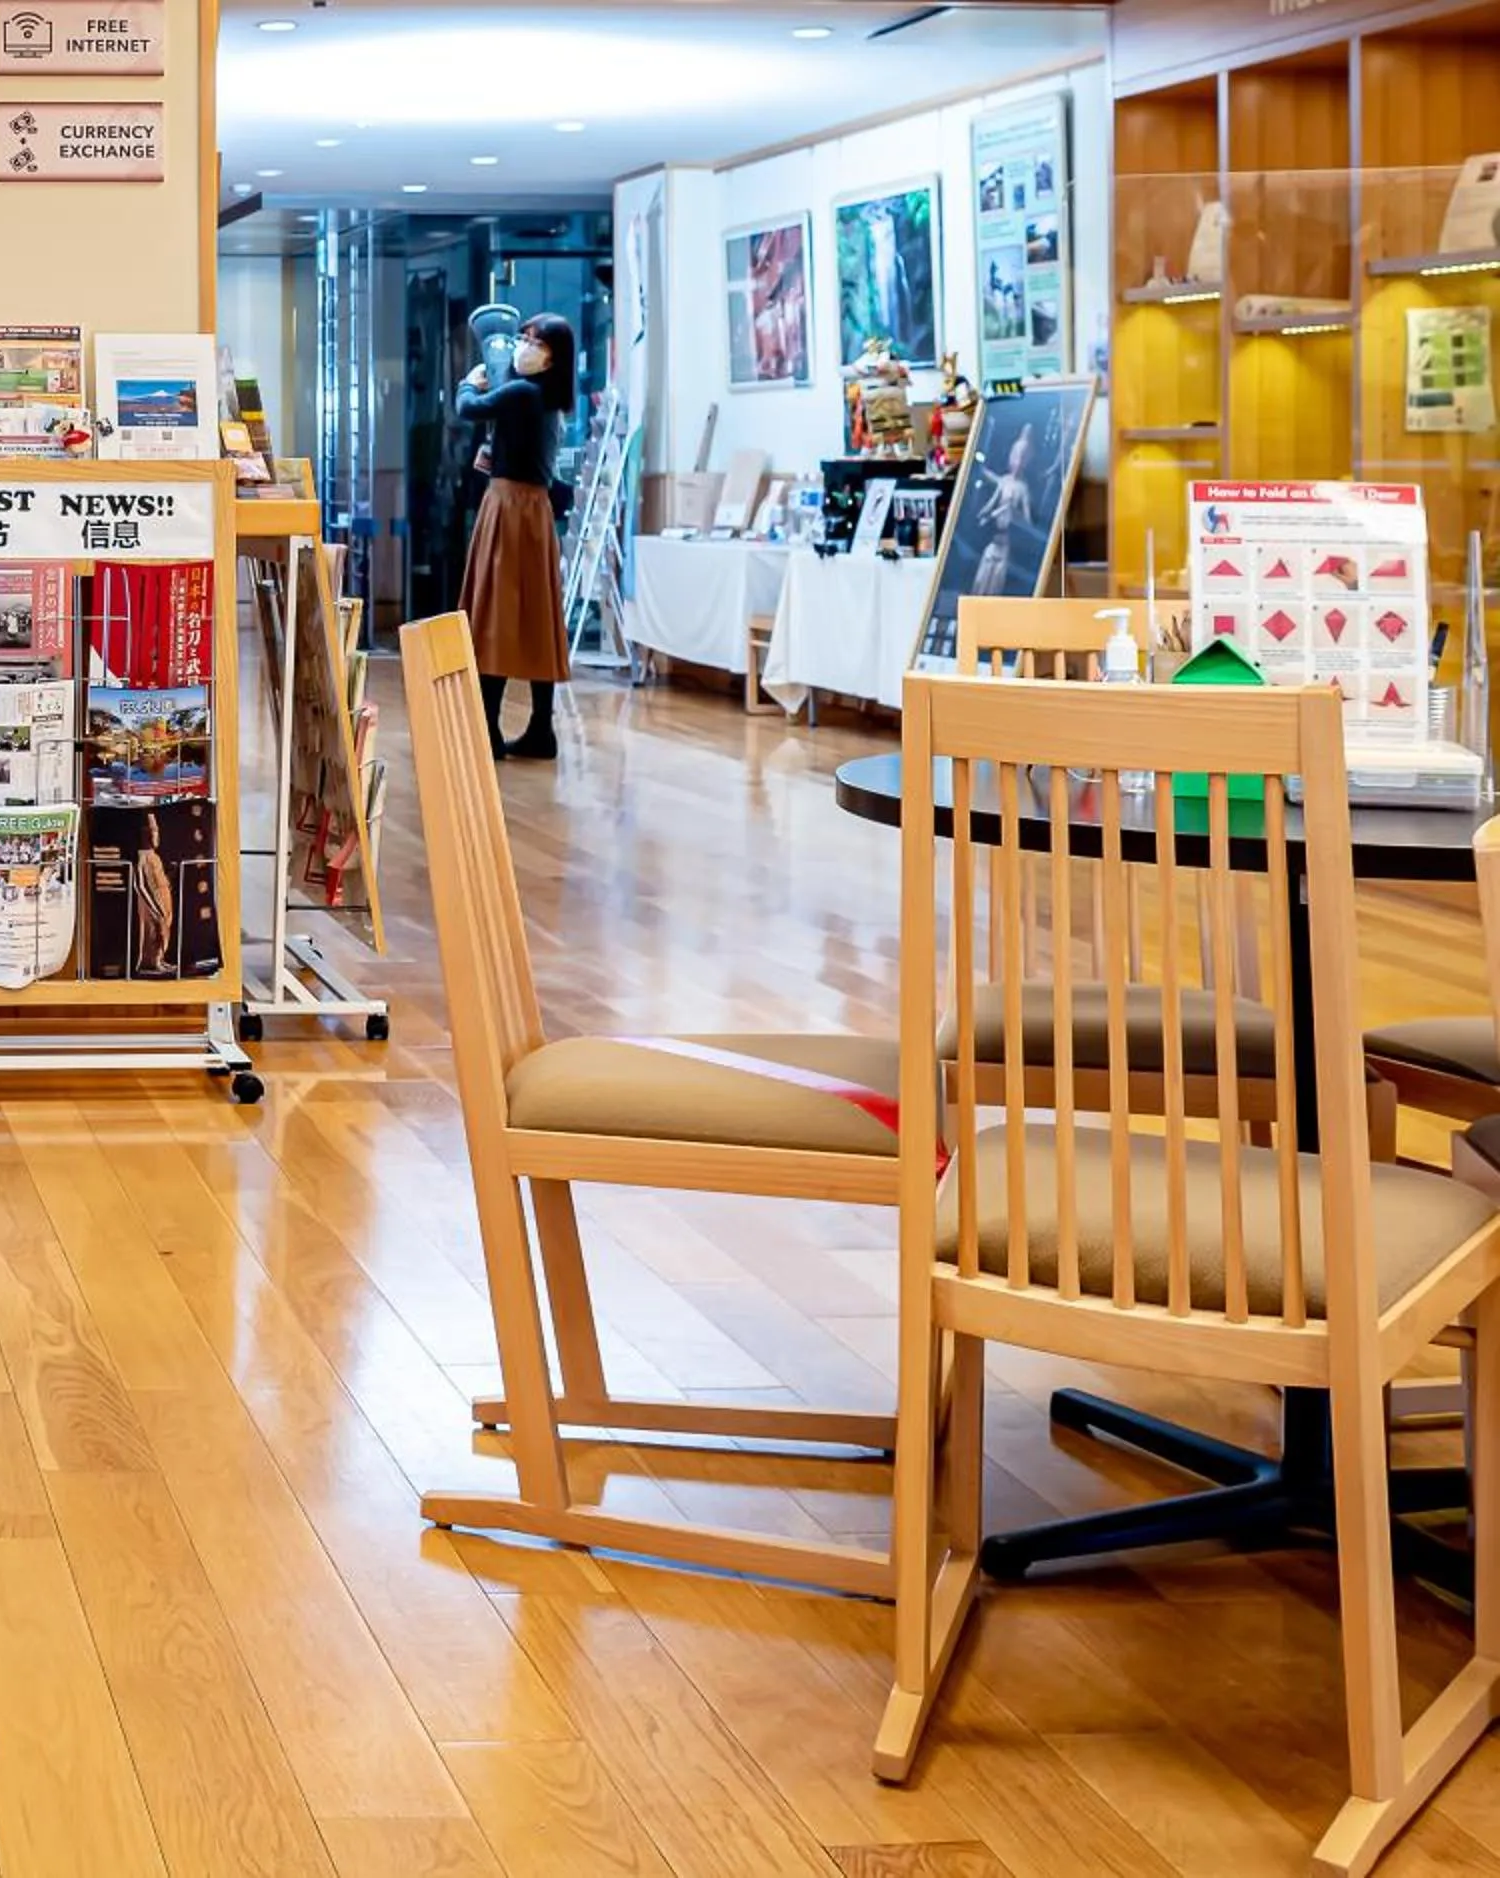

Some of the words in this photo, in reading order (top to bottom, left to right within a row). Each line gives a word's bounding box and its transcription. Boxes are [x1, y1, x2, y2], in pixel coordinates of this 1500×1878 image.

[86, 19, 129, 34] FREE
[65, 38, 151, 53] INTERNET
[60, 125, 155, 140] CURRENCY
[58, 145, 156, 159] EXCHANGE
[1207, 485, 1239, 498] How
[1241, 486, 1257, 498] to
[1258, 485, 1288, 499] Fold
[59, 493, 175, 518] NEWS!!
[81, 519, 141, 550] 信息
